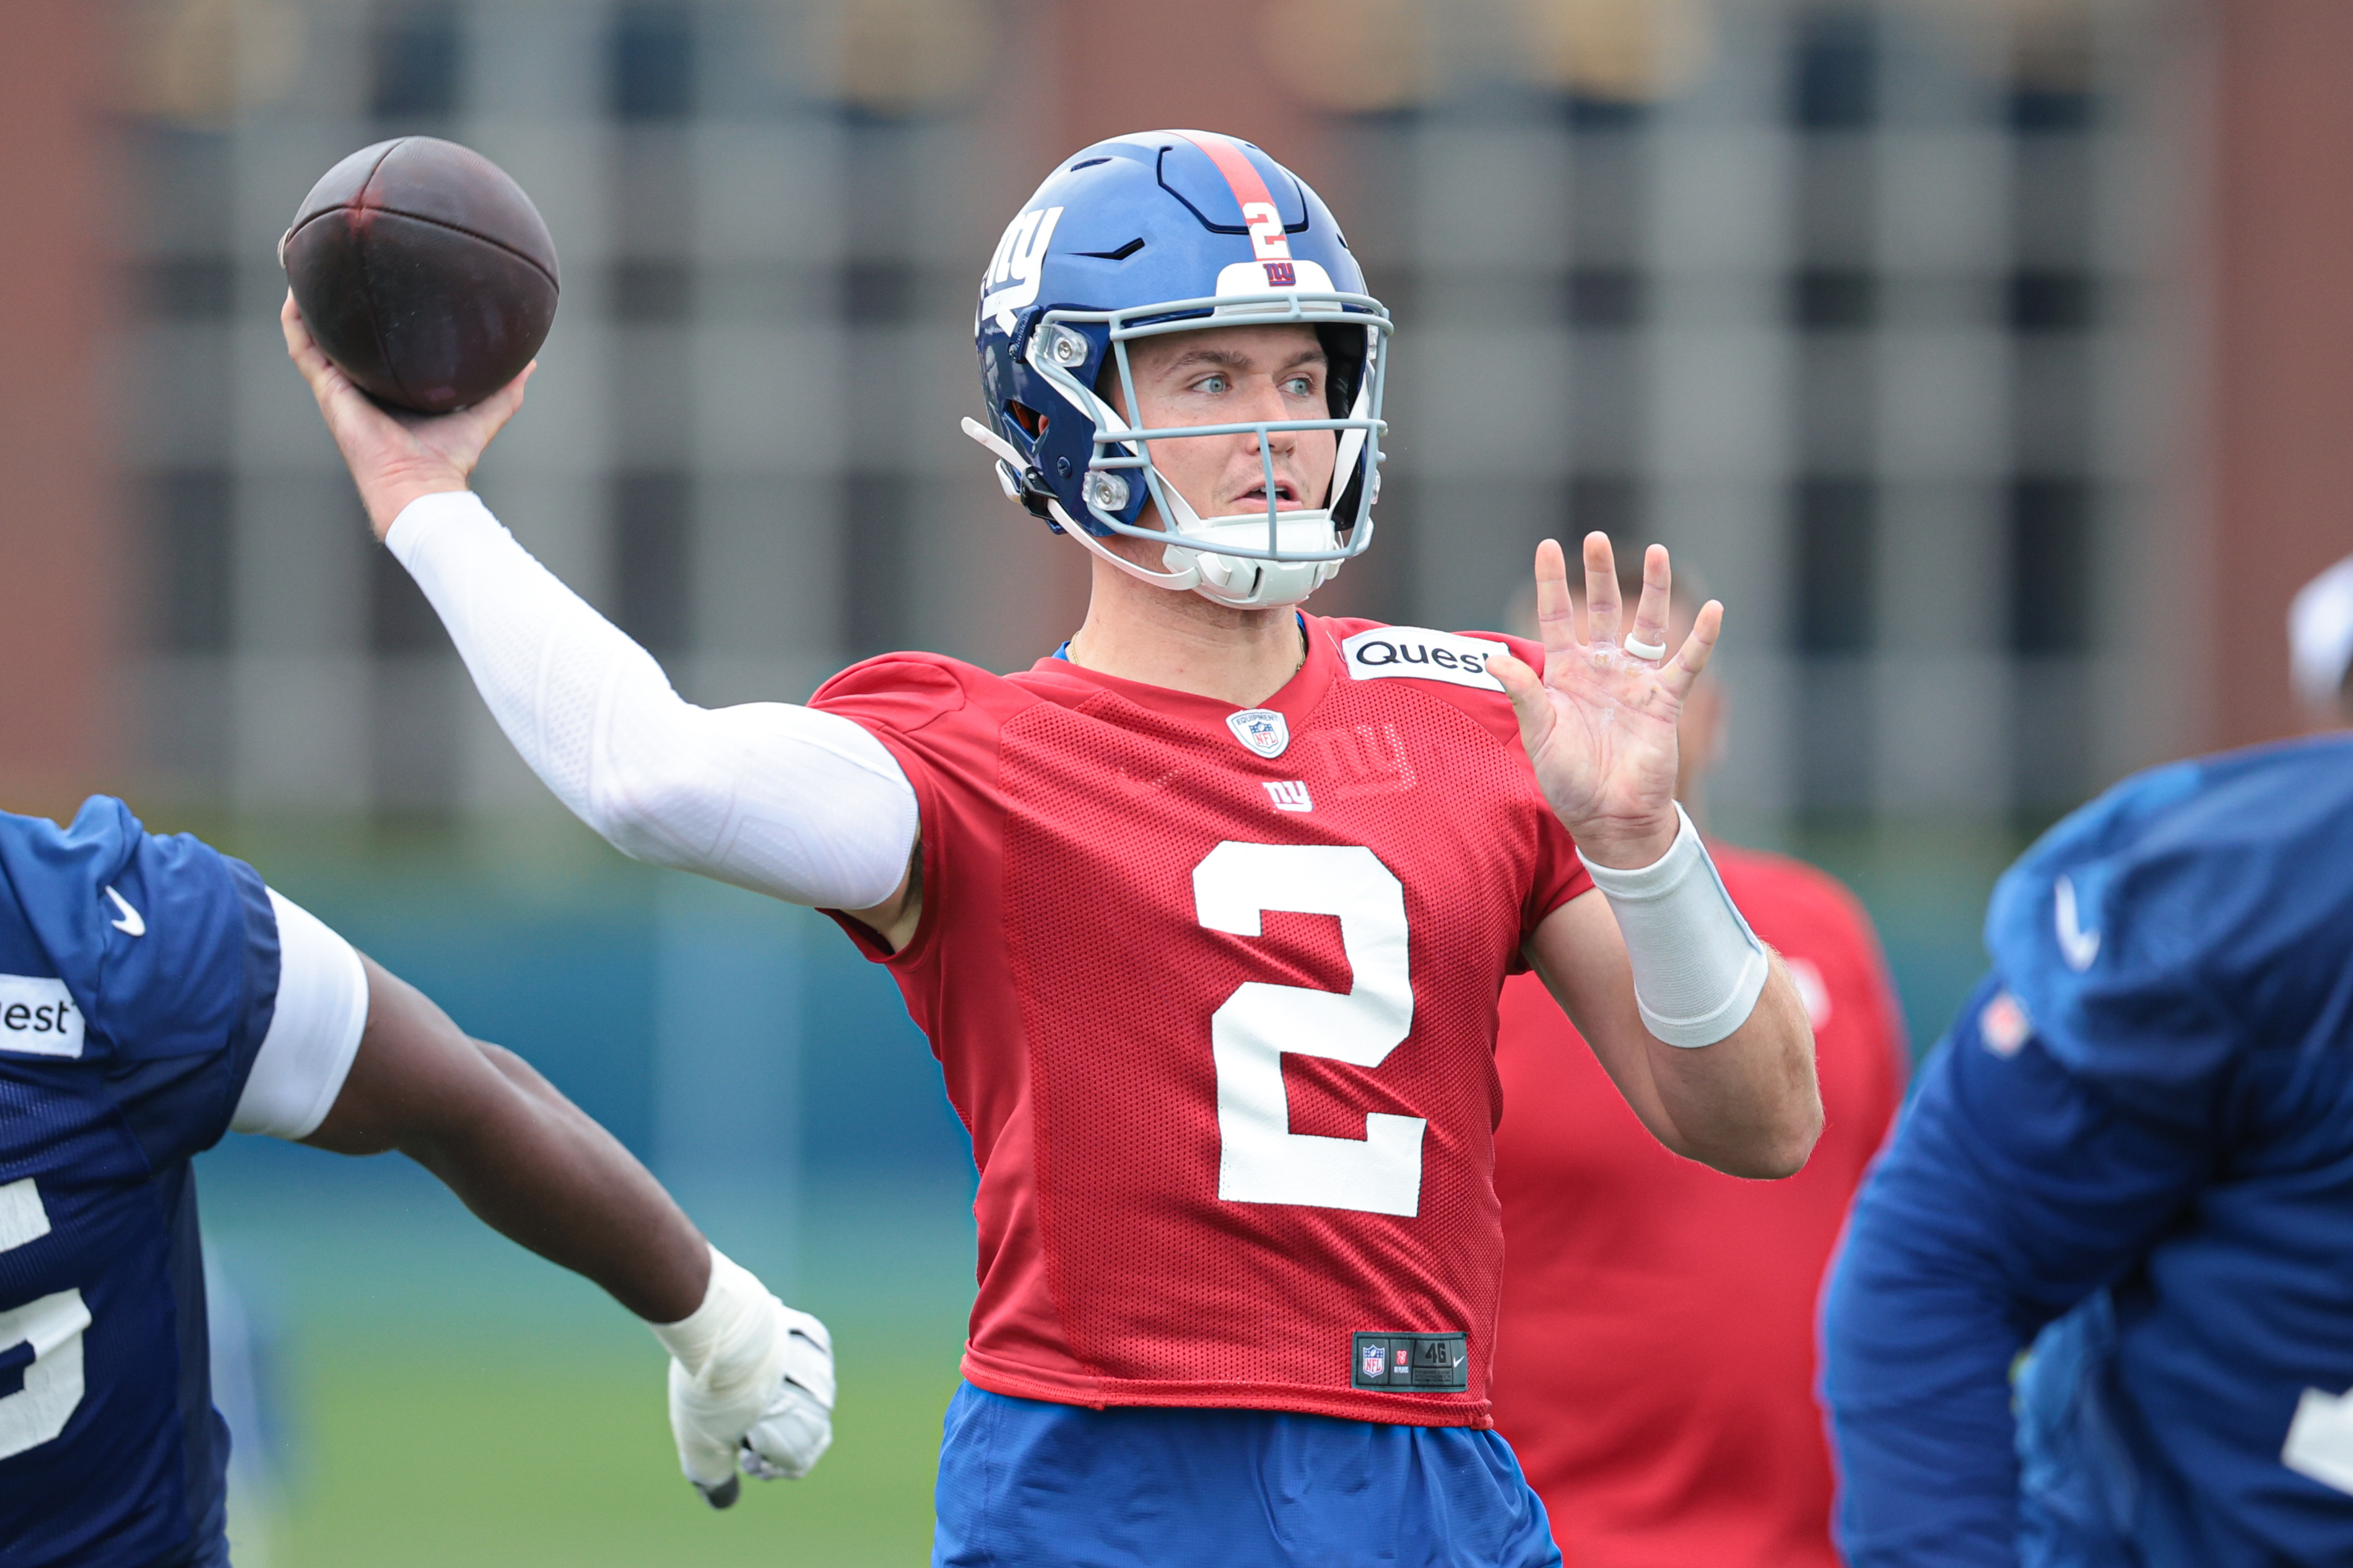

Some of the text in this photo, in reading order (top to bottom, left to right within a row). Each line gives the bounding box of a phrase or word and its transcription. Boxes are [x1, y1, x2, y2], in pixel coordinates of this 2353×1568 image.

[1242, 203, 1290, 258] 2
[1237, 715, 1279, 725] EQUIPMENT
[1255, 733, 1276, 745] NFL
[1192, 840, 1427, 1217] 2
[1425, 1342, 1446, 1363] 46
[1365, 1358, 1382, 1372] NFL
